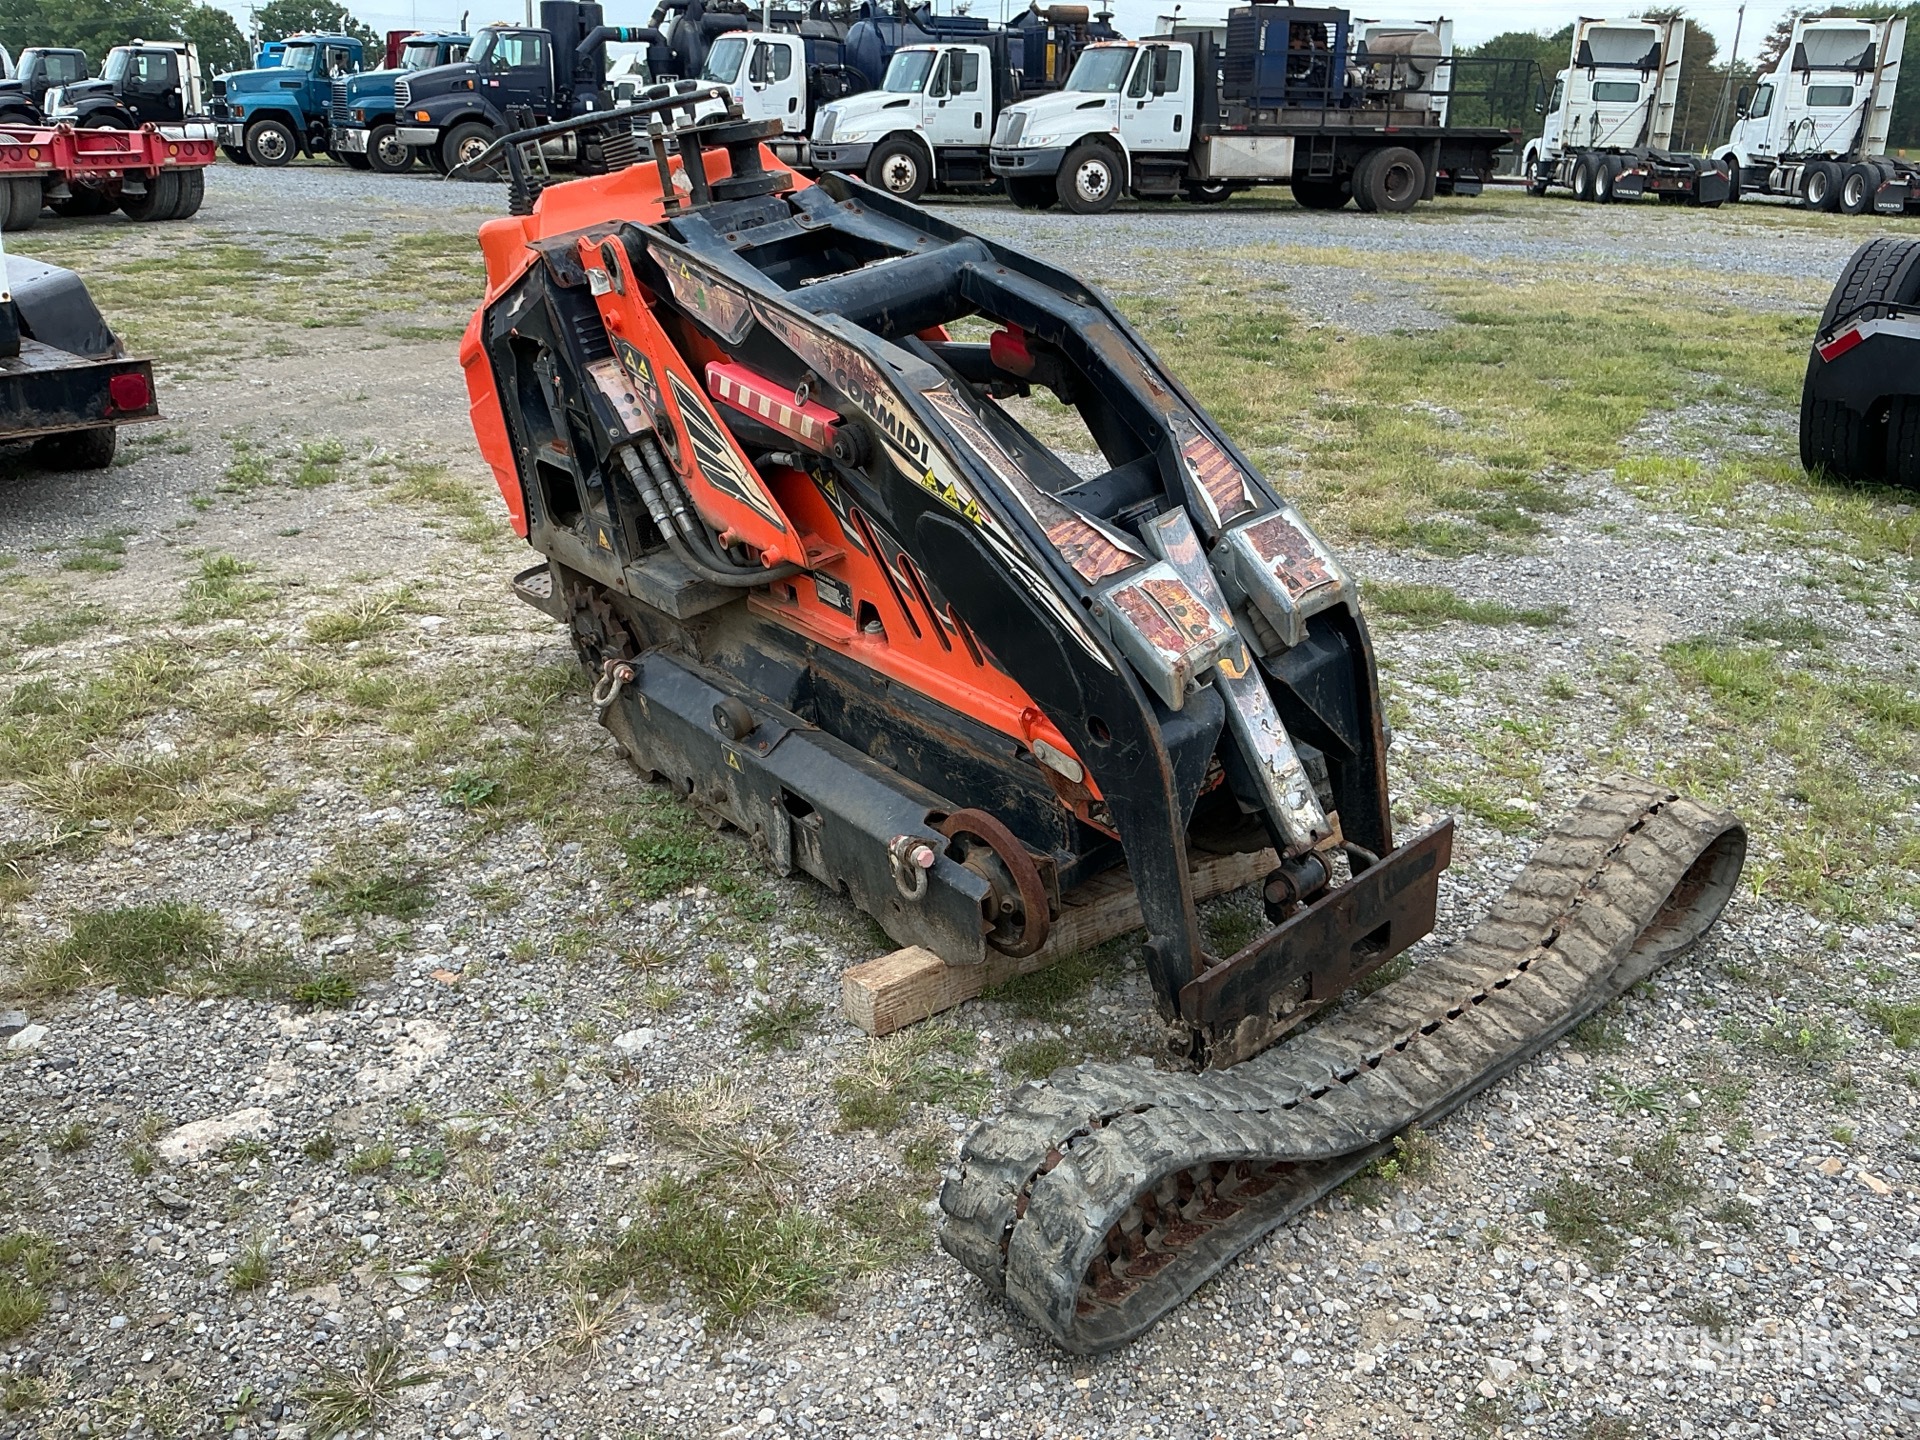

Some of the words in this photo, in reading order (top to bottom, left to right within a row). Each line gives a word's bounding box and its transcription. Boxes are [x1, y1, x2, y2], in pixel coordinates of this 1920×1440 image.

[1616, 188, 1640, 196] VOLVO
[857, 371, 895, 405] LOADER
[834, 368, 930, 466] CORMIDI
